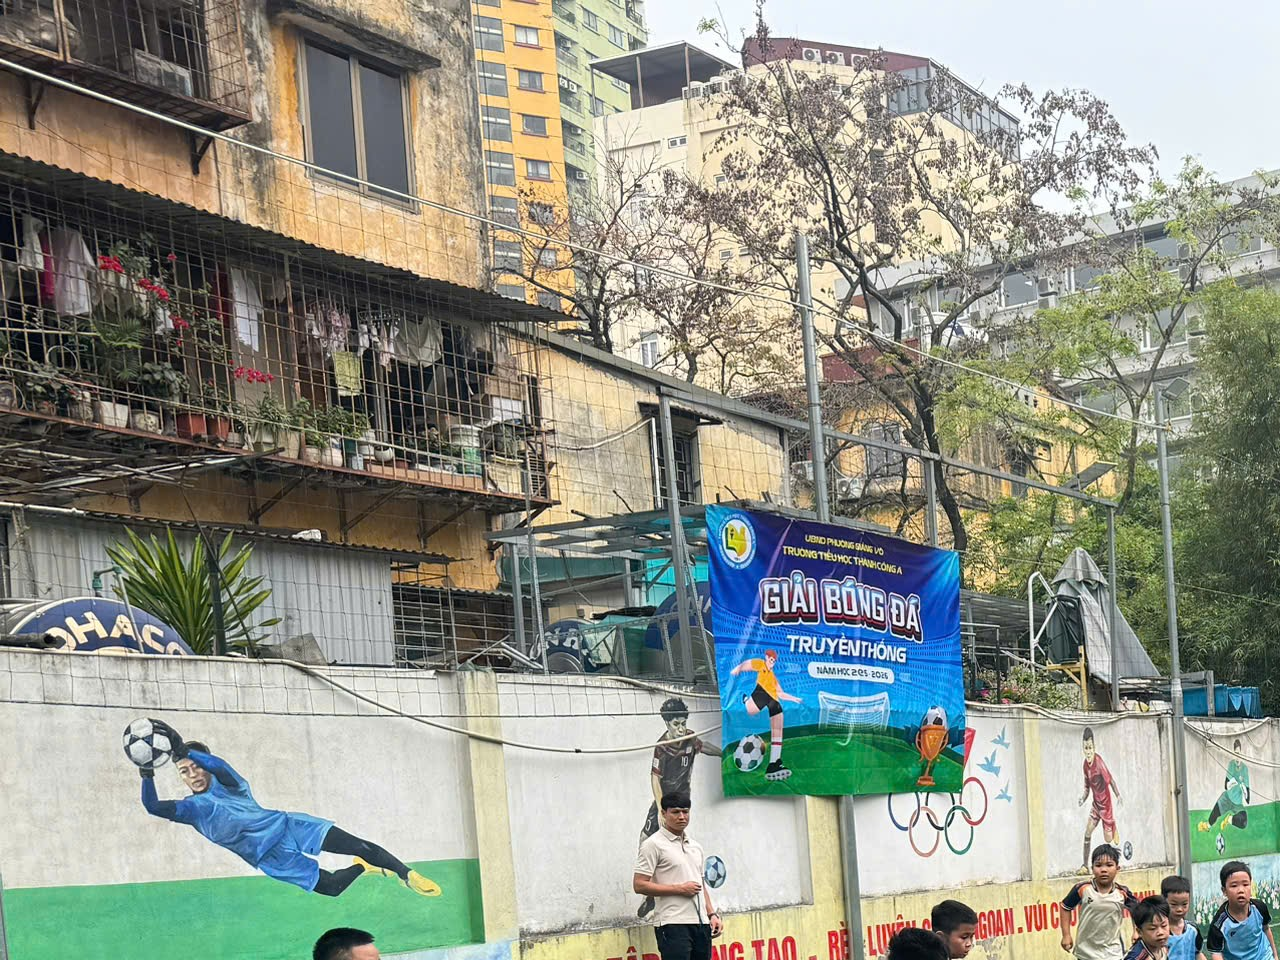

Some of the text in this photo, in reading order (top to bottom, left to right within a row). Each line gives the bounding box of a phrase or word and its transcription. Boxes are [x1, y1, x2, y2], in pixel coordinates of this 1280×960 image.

[761, 572, 817, 619] GIẢI
[821, 578, 887, 627] BÓNG
[889, 595, 922, 637] ĐÁ
[786, 632, 907, 663] TRUYỀN THỐNG
[867, 914, 916, 956] LUY
